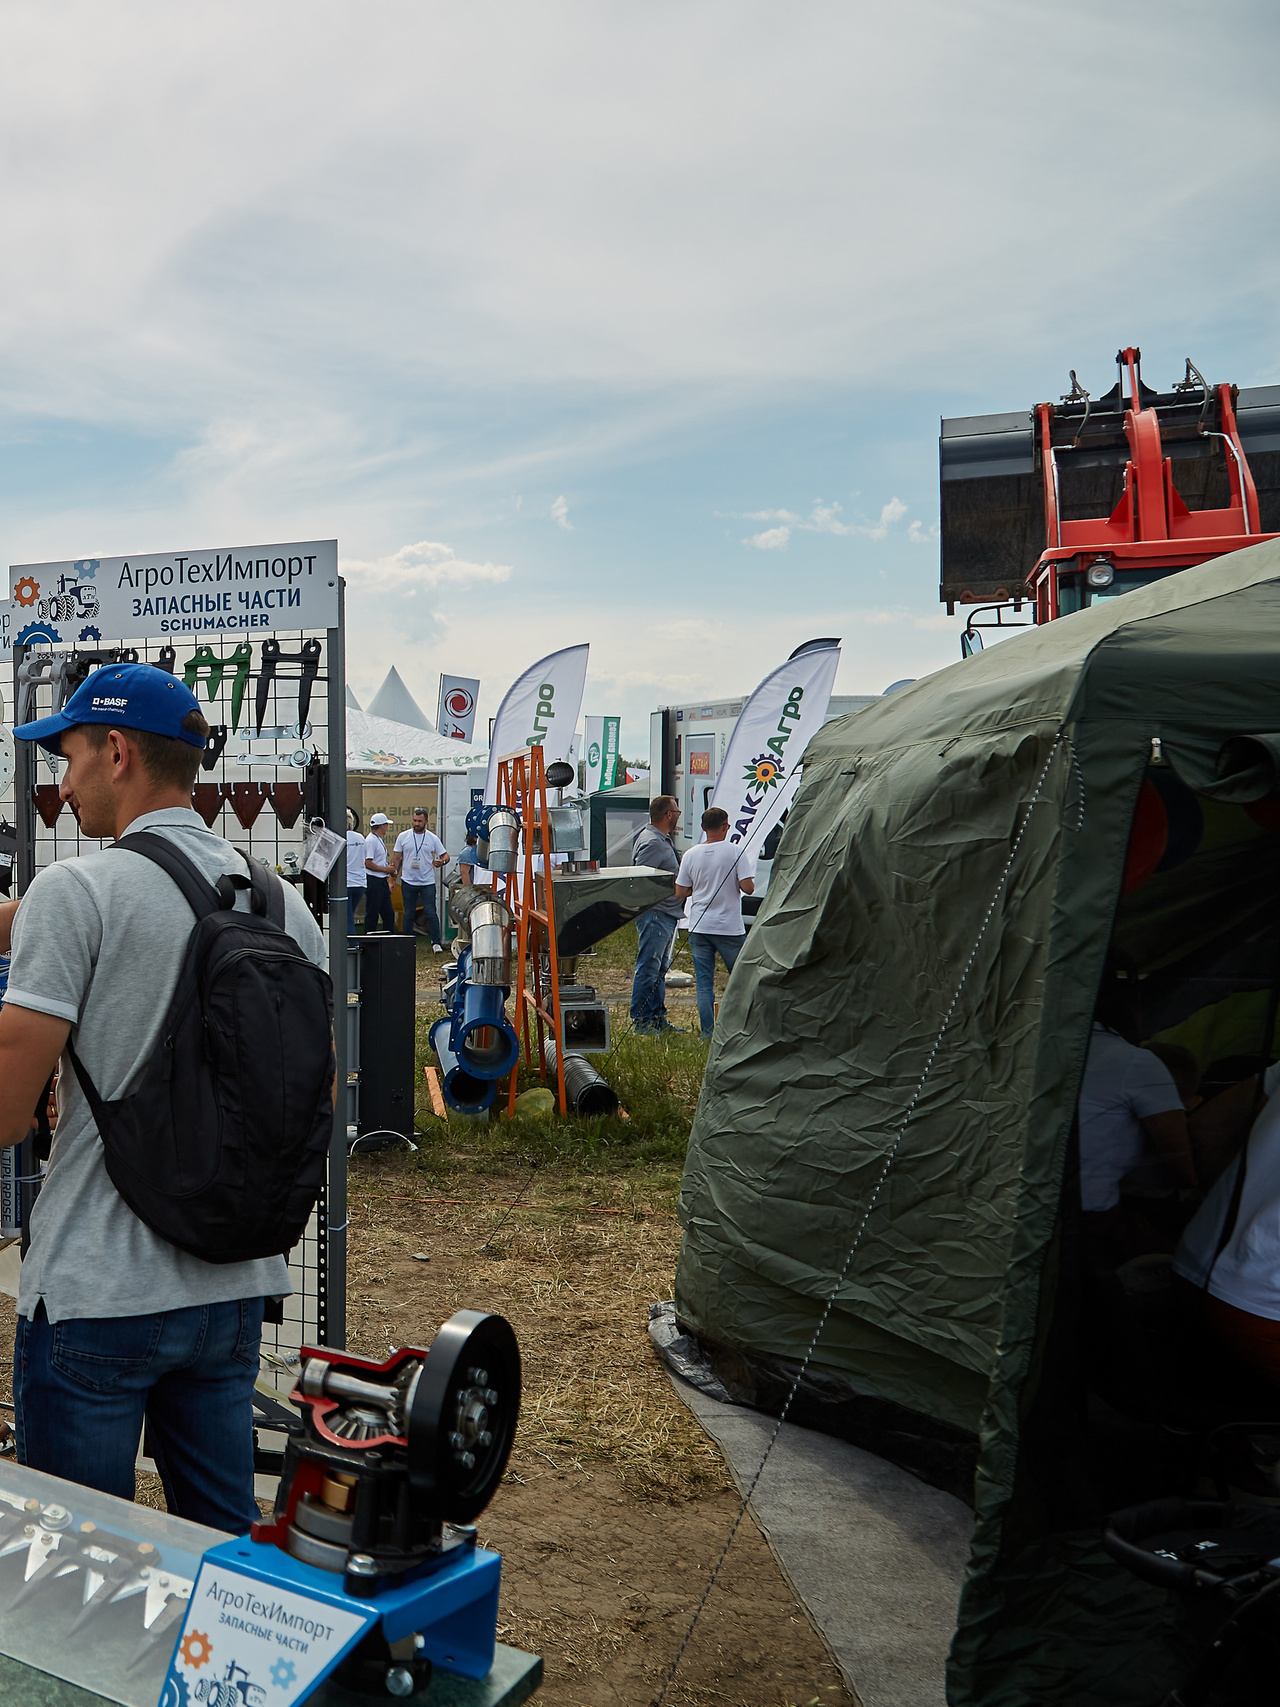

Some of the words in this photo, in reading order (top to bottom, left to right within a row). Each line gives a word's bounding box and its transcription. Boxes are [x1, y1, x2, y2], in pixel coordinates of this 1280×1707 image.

[118, 555, 317, 593] АгроТехИмпорт
[131, 596, 231, 617] ЗАПАСНЫЕ
[237, 588, 301, 611] ЧАСТИ
[160, 614, 270, 632] SCHUMACHER
[103, 697, 128, 707] BASF
[207, 1582, 334, 1641] АгроТехИмпорт
[218, 1612, 273, 1641] ЗАПАСНЫЕ
[275, 1633, 309, 1654] ЧАСТИ
